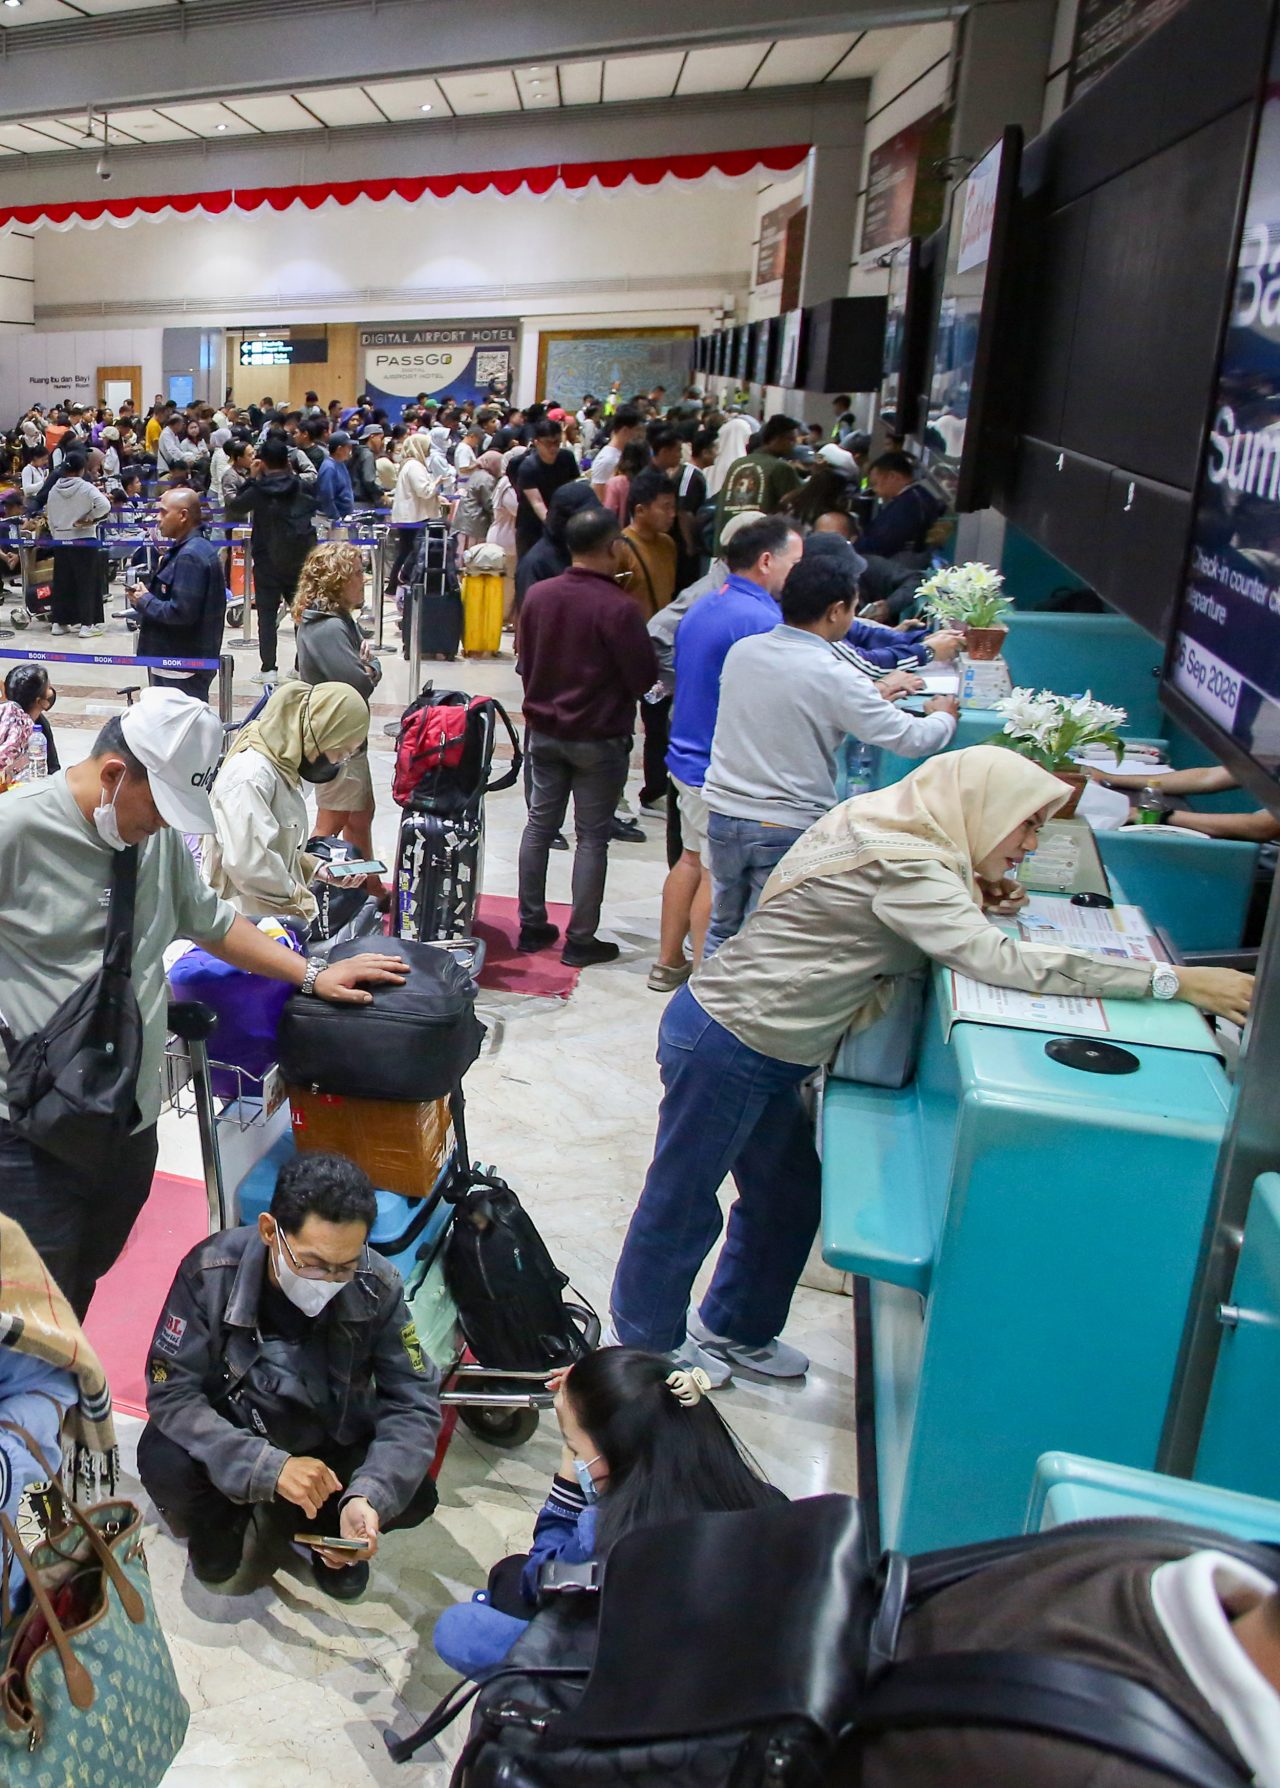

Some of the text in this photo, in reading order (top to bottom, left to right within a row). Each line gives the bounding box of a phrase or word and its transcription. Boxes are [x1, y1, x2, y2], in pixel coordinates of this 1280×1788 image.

[362, 329, 515, 345] DIGITAL AIRPORT HOTEL
[376, 353, 452, 366] PASSGO
[75, 375, 90, 383] Bayi
[1229, 570, 1268, 604] counter
[1187, 649, 1206, 688] Sep
[1207, 664, 1238, 709] 2026
